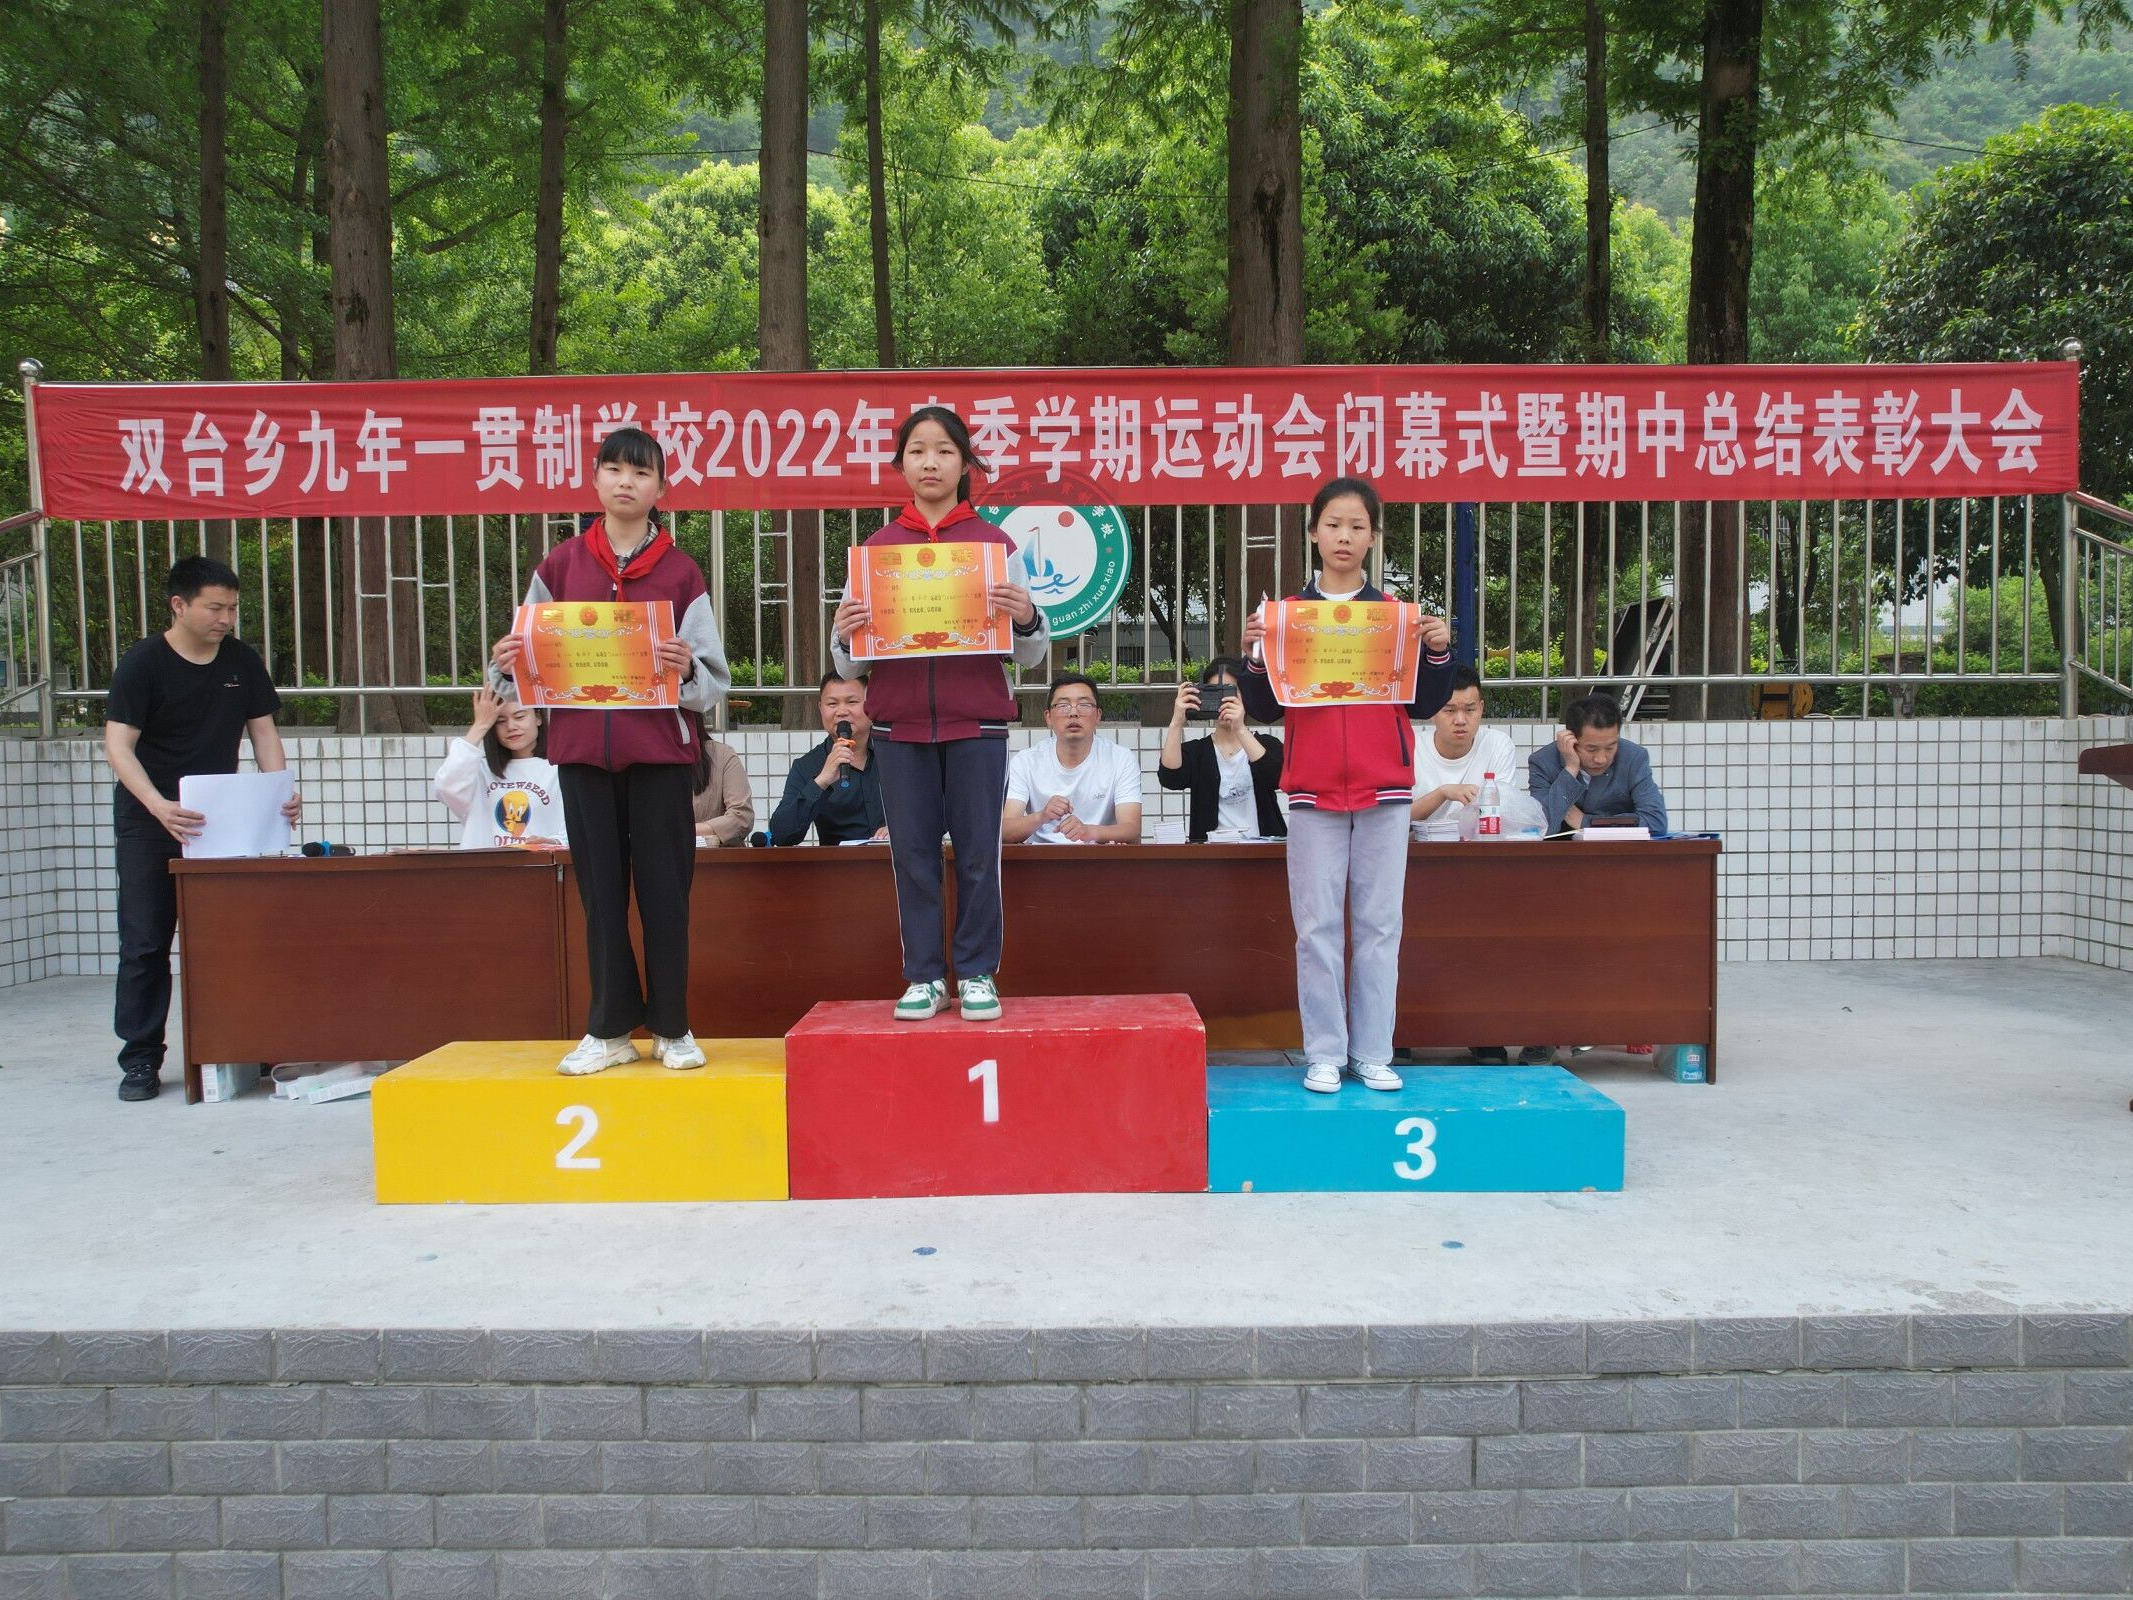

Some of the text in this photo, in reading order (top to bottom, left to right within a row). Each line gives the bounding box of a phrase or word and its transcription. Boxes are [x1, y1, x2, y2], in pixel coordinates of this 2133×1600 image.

[118, 387, 2043, 497] 双台乡九年一贯制校2022年季学期运动会闭幕式暨期中总结表彰大会
[1052, 560, 1116, 626] guan zhi xue xiao
[969, 1060, 999, 1122] 1
[556, 1105, 601, 1169] 2
[1395, 1118, 1436, 1179] 3
